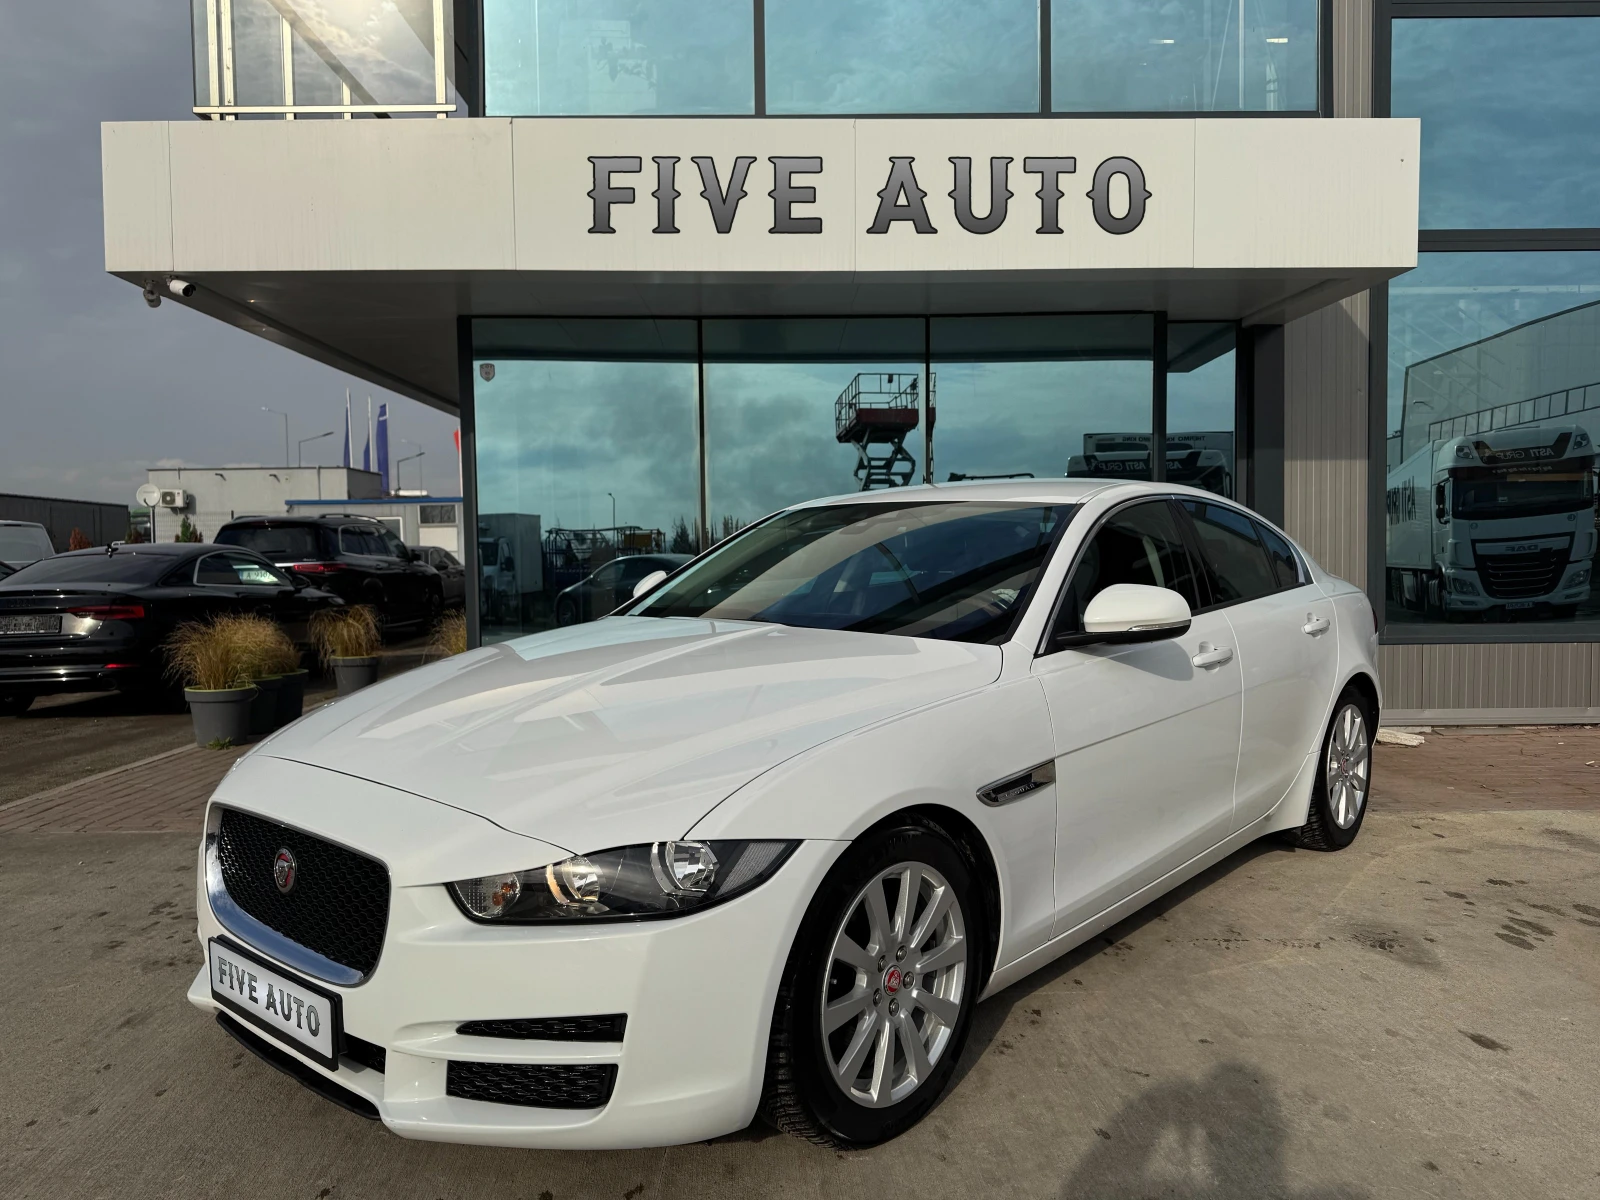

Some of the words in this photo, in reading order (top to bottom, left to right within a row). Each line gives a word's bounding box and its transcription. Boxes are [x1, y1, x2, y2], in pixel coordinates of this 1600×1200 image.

[587, 156, 823, 234] FIVE
[866, 156, 1152, 234] AUTO
[217, 955, 259, 1004] FIVE
[265, 984, 321, 1037] AUTO
